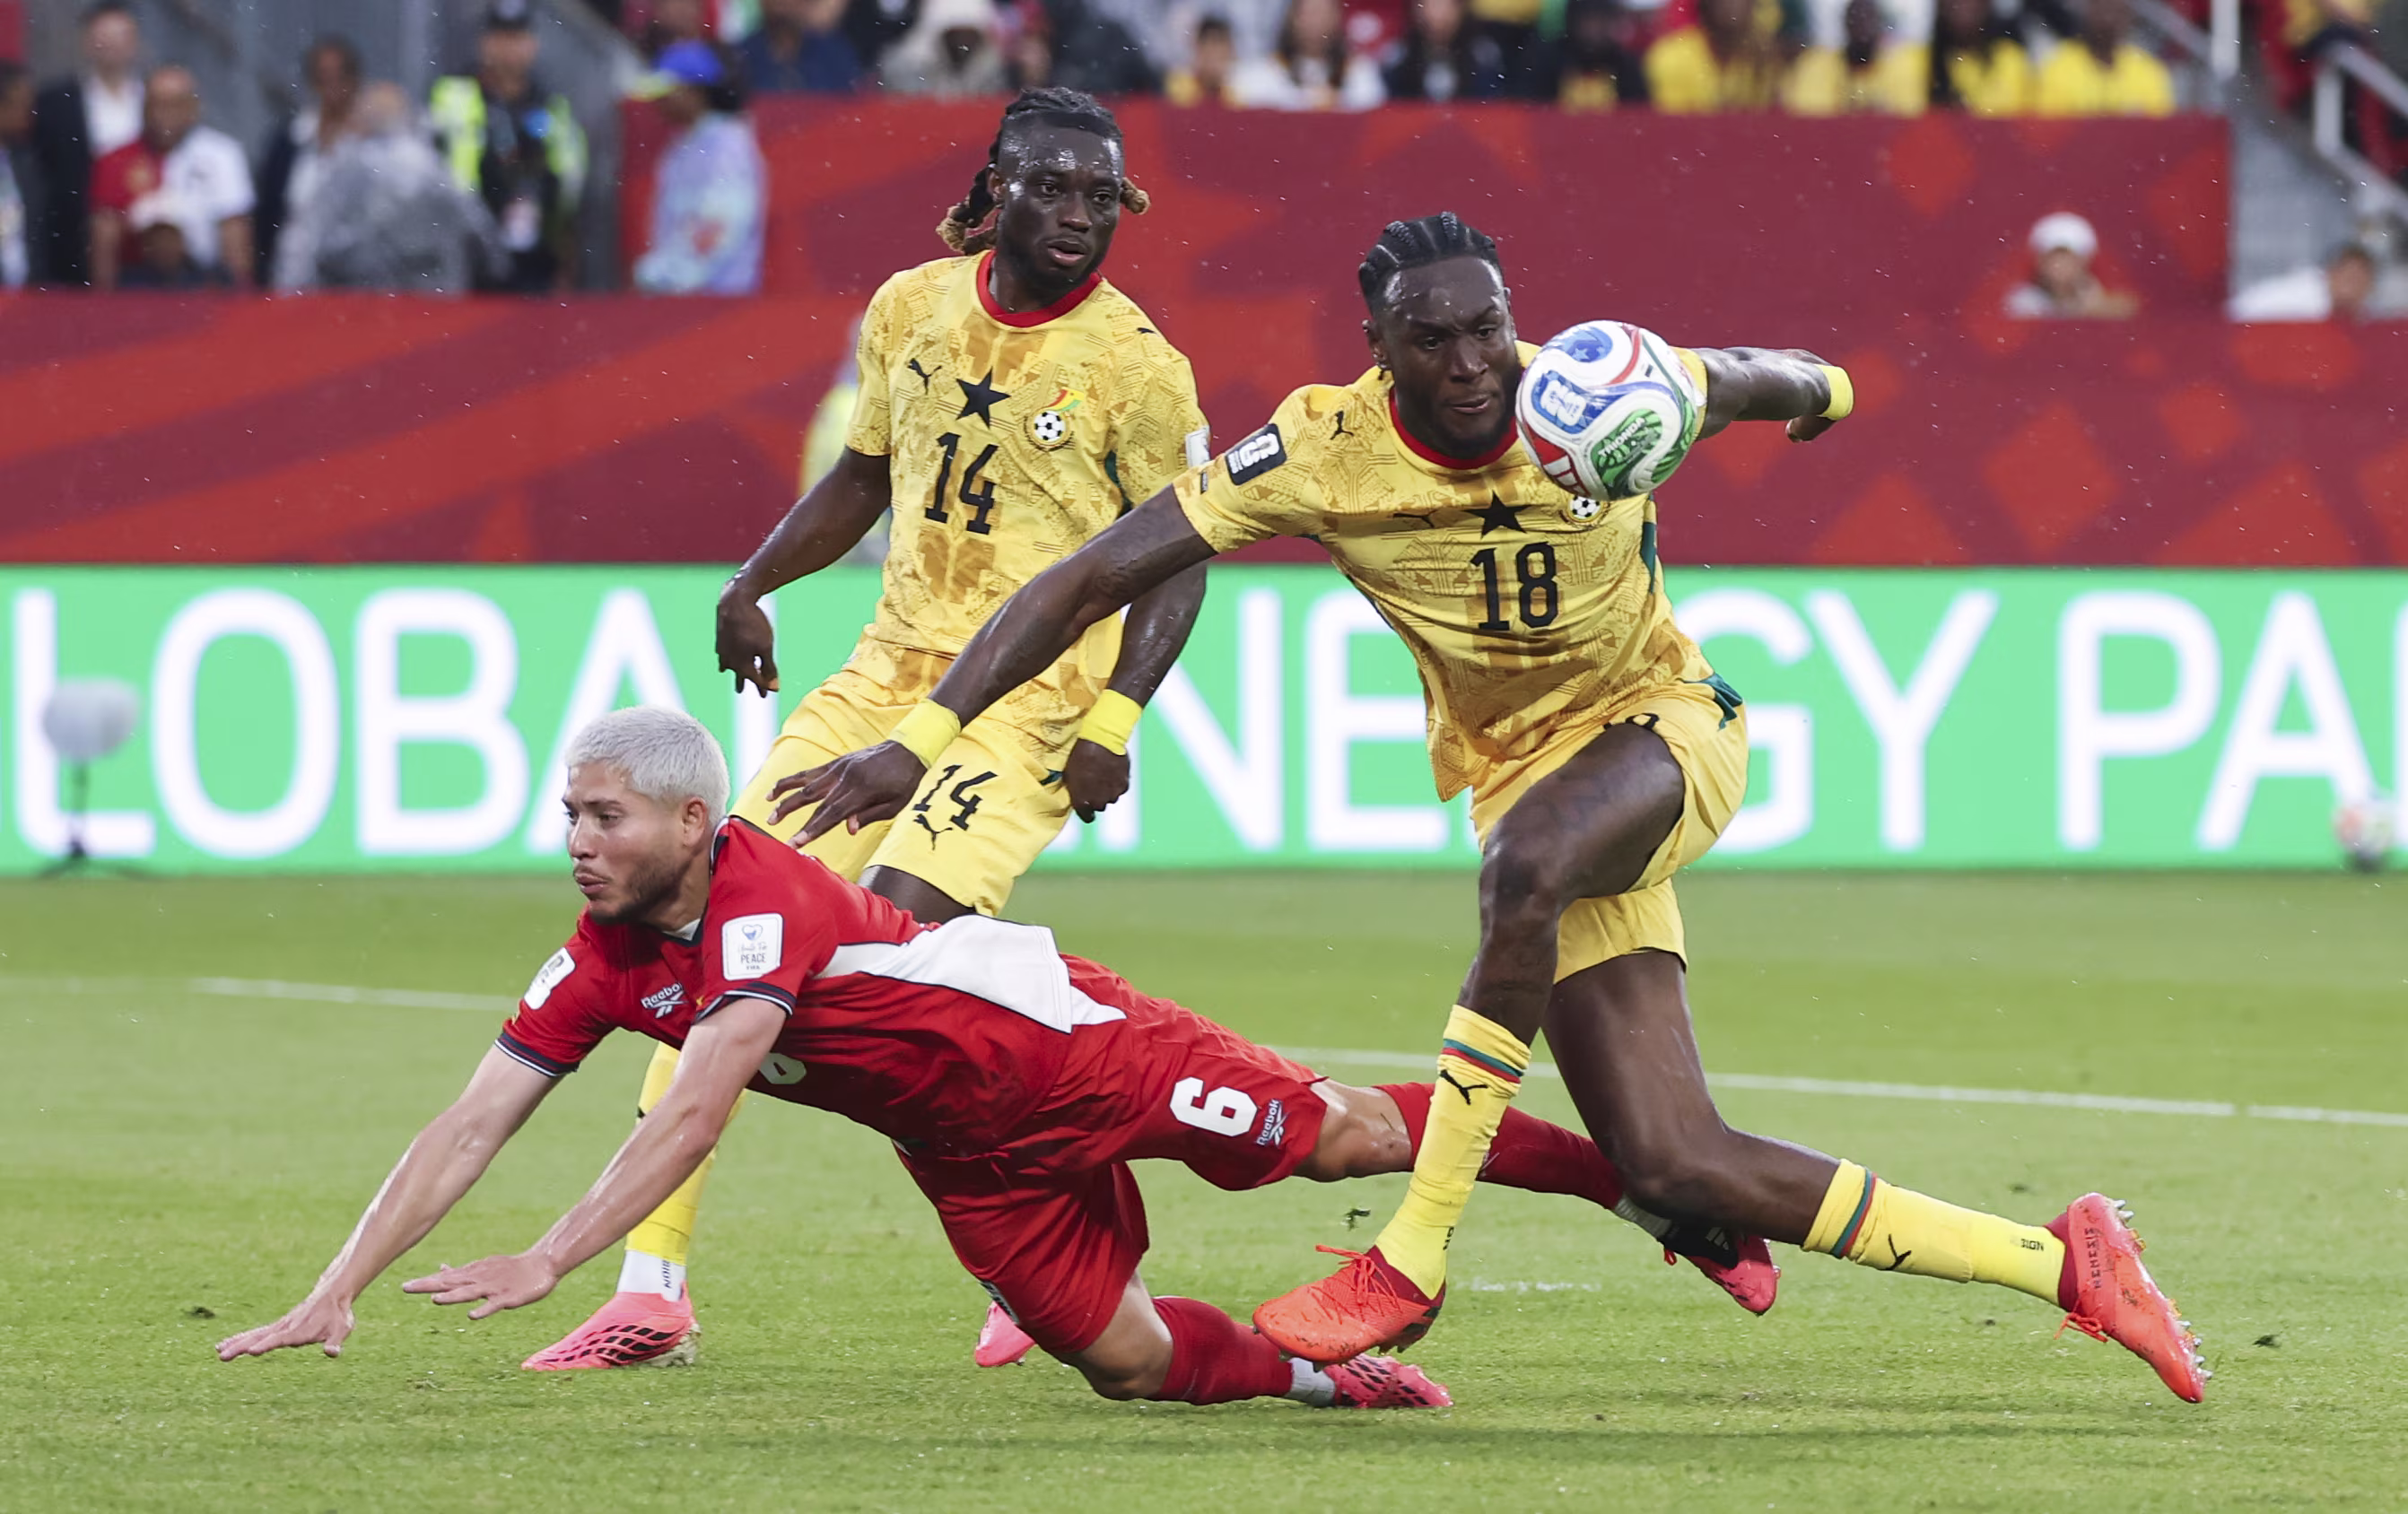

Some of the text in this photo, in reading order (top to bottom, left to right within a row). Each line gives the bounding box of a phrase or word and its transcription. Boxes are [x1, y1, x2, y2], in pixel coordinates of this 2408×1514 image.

[1598, 416, 1646, 458] TRIONDA
[924, 431, 999, 536] 14
[1470, 541, 1558, 631] 18
[2058, 588, 2408, 852] PA
[912, 764, 999, 831] 14
[741, 953, 767, 964] PEACE
[1169, 1076, 1258, 1137] 6
[1256, 1098, 1280, 1146] Reebok
